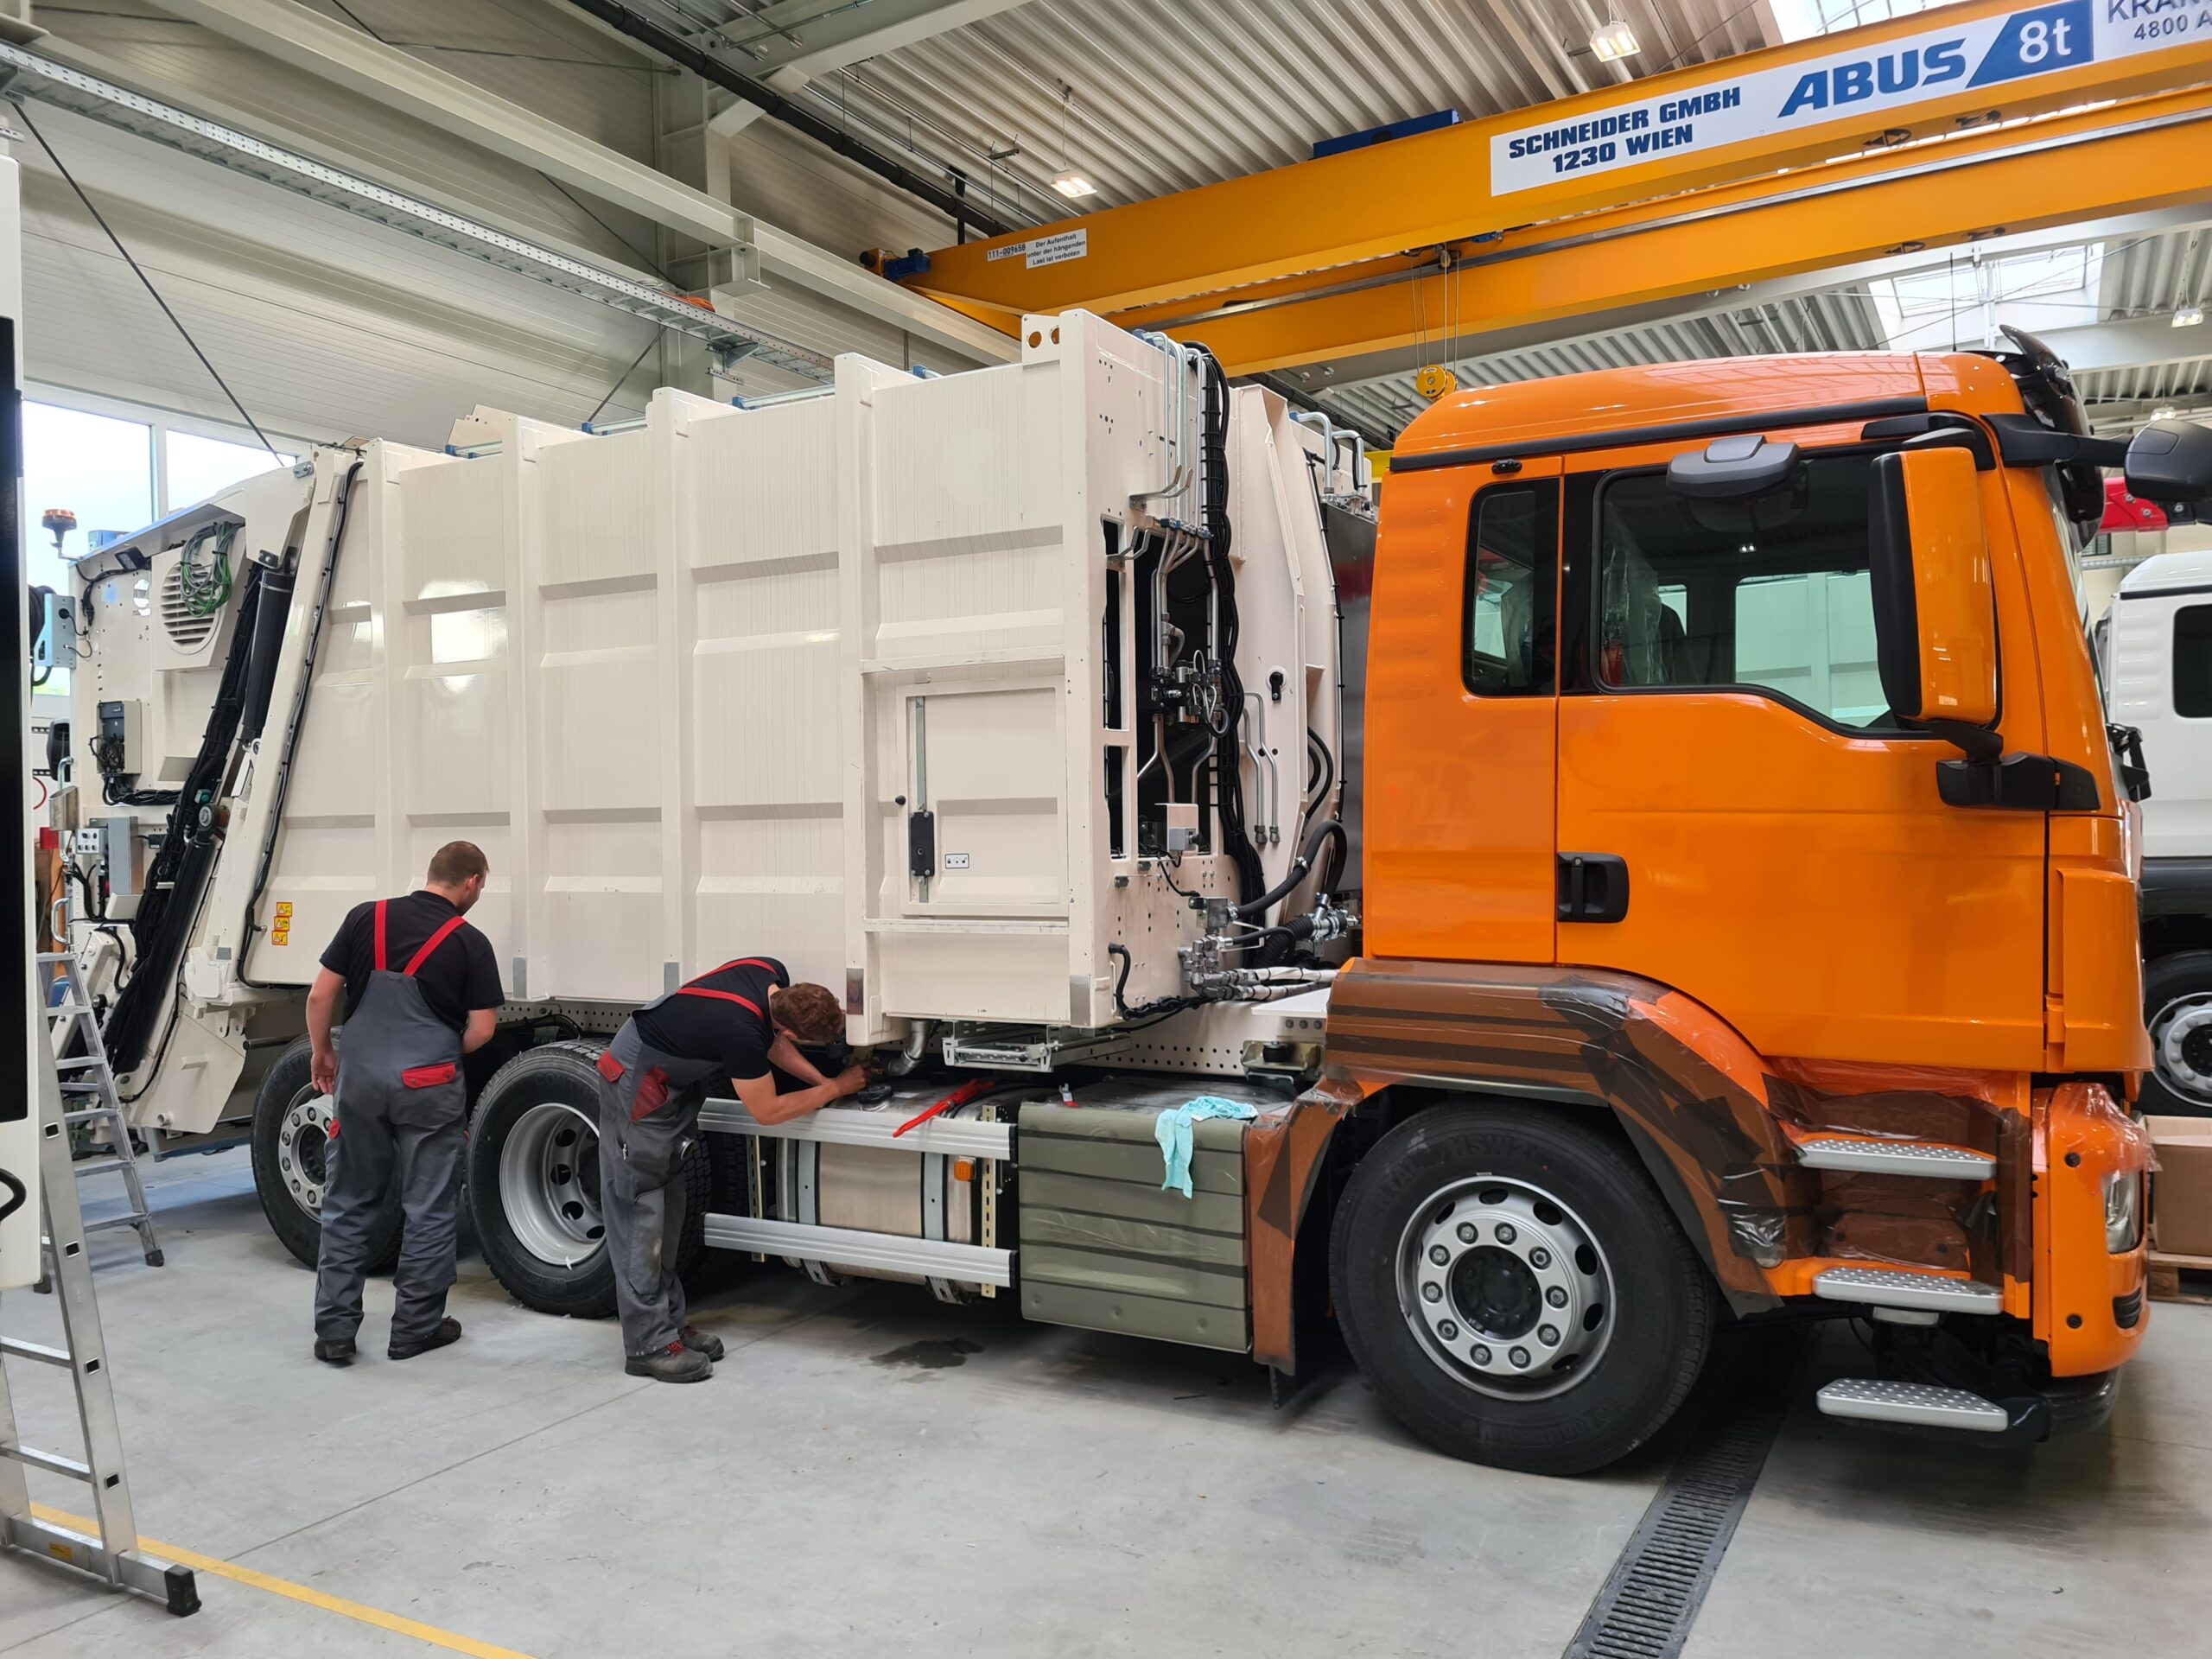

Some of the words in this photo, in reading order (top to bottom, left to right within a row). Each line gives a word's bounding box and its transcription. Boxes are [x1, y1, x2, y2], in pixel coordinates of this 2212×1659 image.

[2019, 18, 2071, 63] 8t
[2133, 14, 2189, 41] 4800
[1777, 38, 1967, 118] ABUS
[1509, 109, 1649, 159] SCHNEIDER
[1659, 86, 1740, 124] GMBH
[1553, 142, 1616, 174] 1230
[1625, 124, 1694, 156] WIEN
[1046, 234, 1077, 245] Aufenthalt
[1055, 251, 1080, 260] verboten
